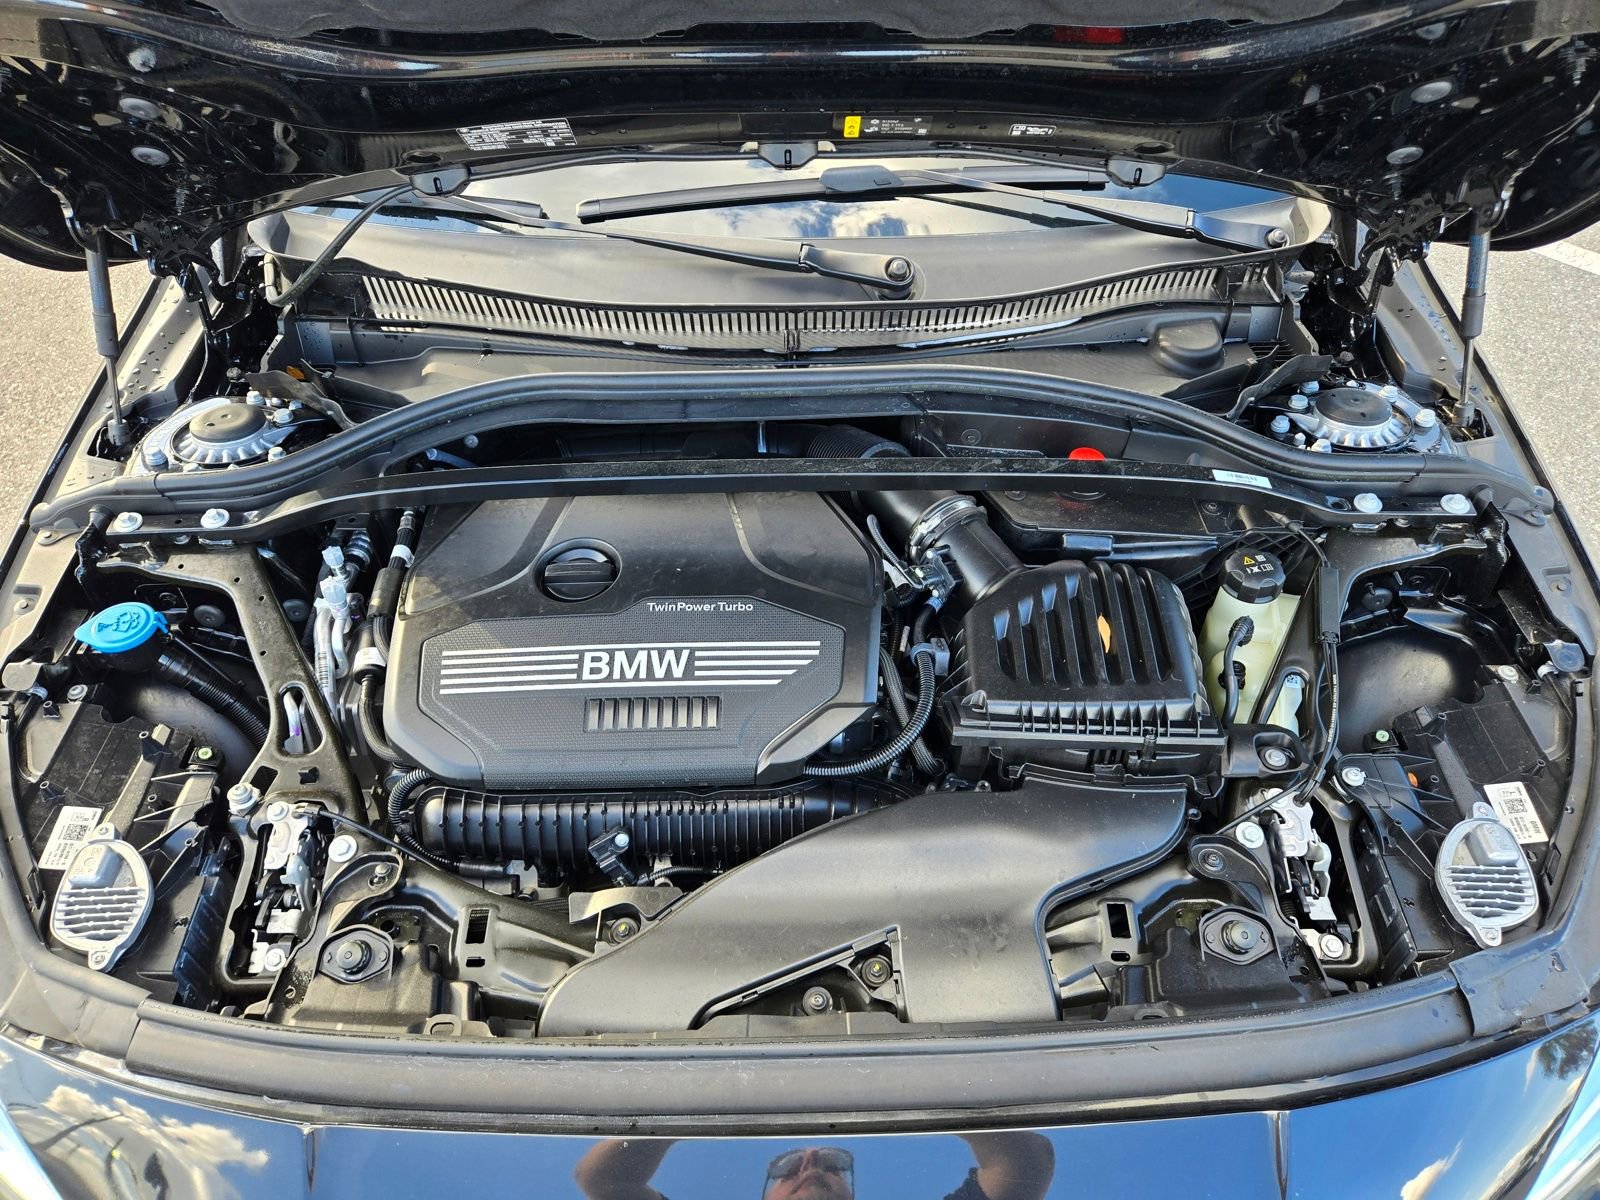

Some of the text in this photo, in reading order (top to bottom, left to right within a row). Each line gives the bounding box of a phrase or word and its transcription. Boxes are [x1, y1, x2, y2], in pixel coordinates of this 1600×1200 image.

[647, 601, 754, 611] TwinPower Turbo
[582, 649, 691, 680] BMW
